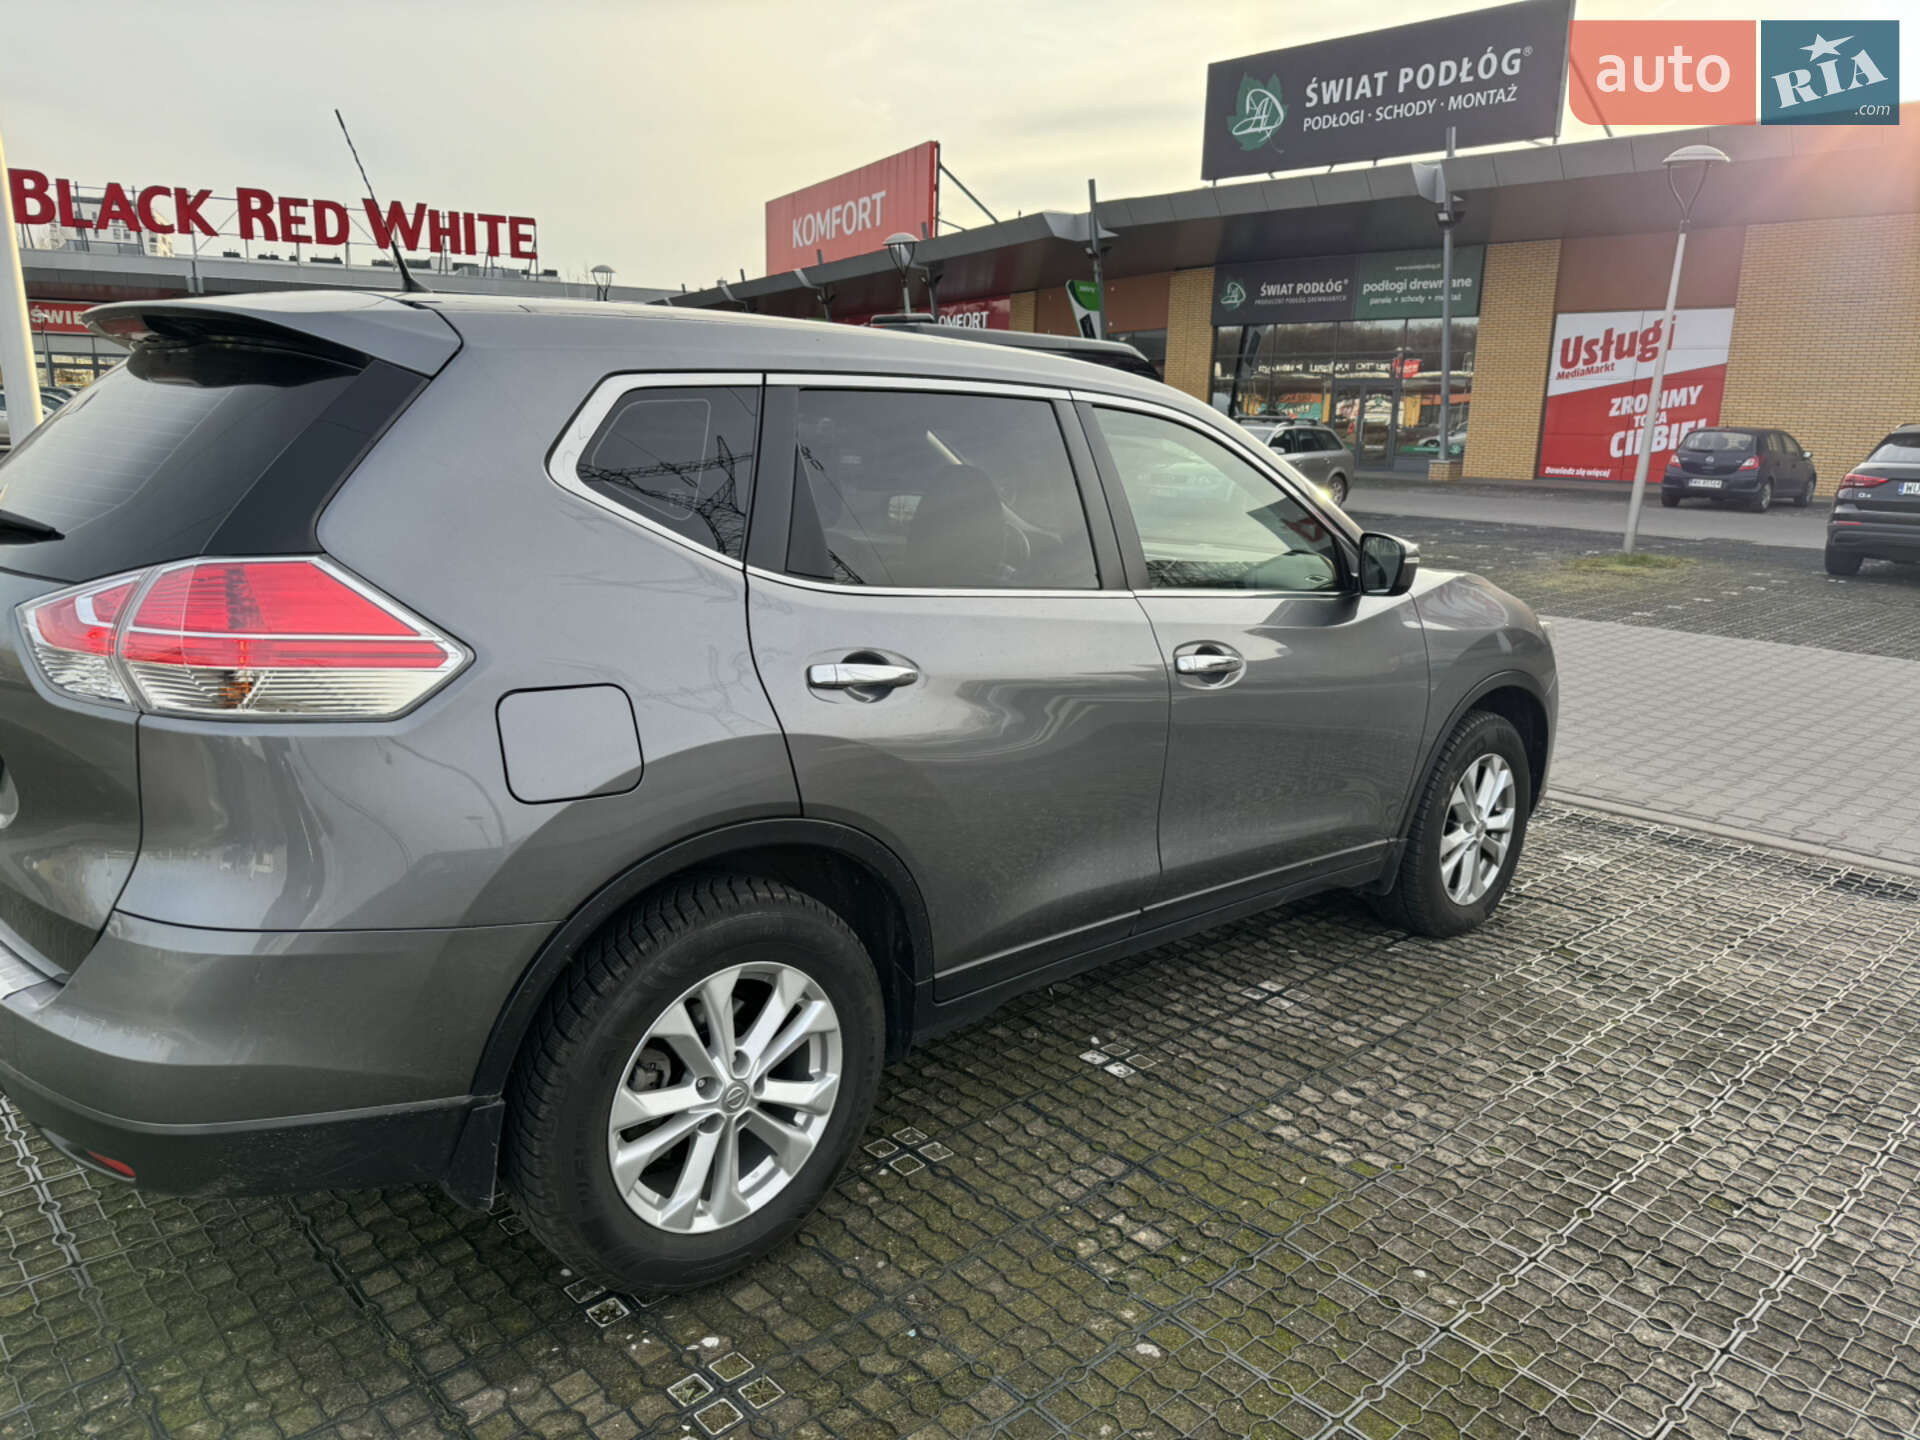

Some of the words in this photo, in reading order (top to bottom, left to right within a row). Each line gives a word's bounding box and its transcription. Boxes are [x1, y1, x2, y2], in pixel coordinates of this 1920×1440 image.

[1305, 71, 1389, 108] ŚWIAT
[1303, 109, 1364, 132] PODŁOGI
[1375, 98, 1437, 122] SCHODY
[1448, 83, 1518, 111] MONTAŻ
[8, 168, 219, 237] BLACK
[236, 187, 350, 246] RED
[362, 198, 538, 260] WHITE
[792, 190, 887, 249] KOMFORT
[1260, 282, 1295, 297] ŚWIAT
[1363, 278, 1408, 295] podłogi
[1409, 277, 1473, 291] drewnane
[938, 311, 990, 330] OMFORT
[1560, 315, 1677, 370] Usługi
[1556, 362, 1616, 380] MediaMarkt
[1608, 384, 1704, 417] ZROIMY
